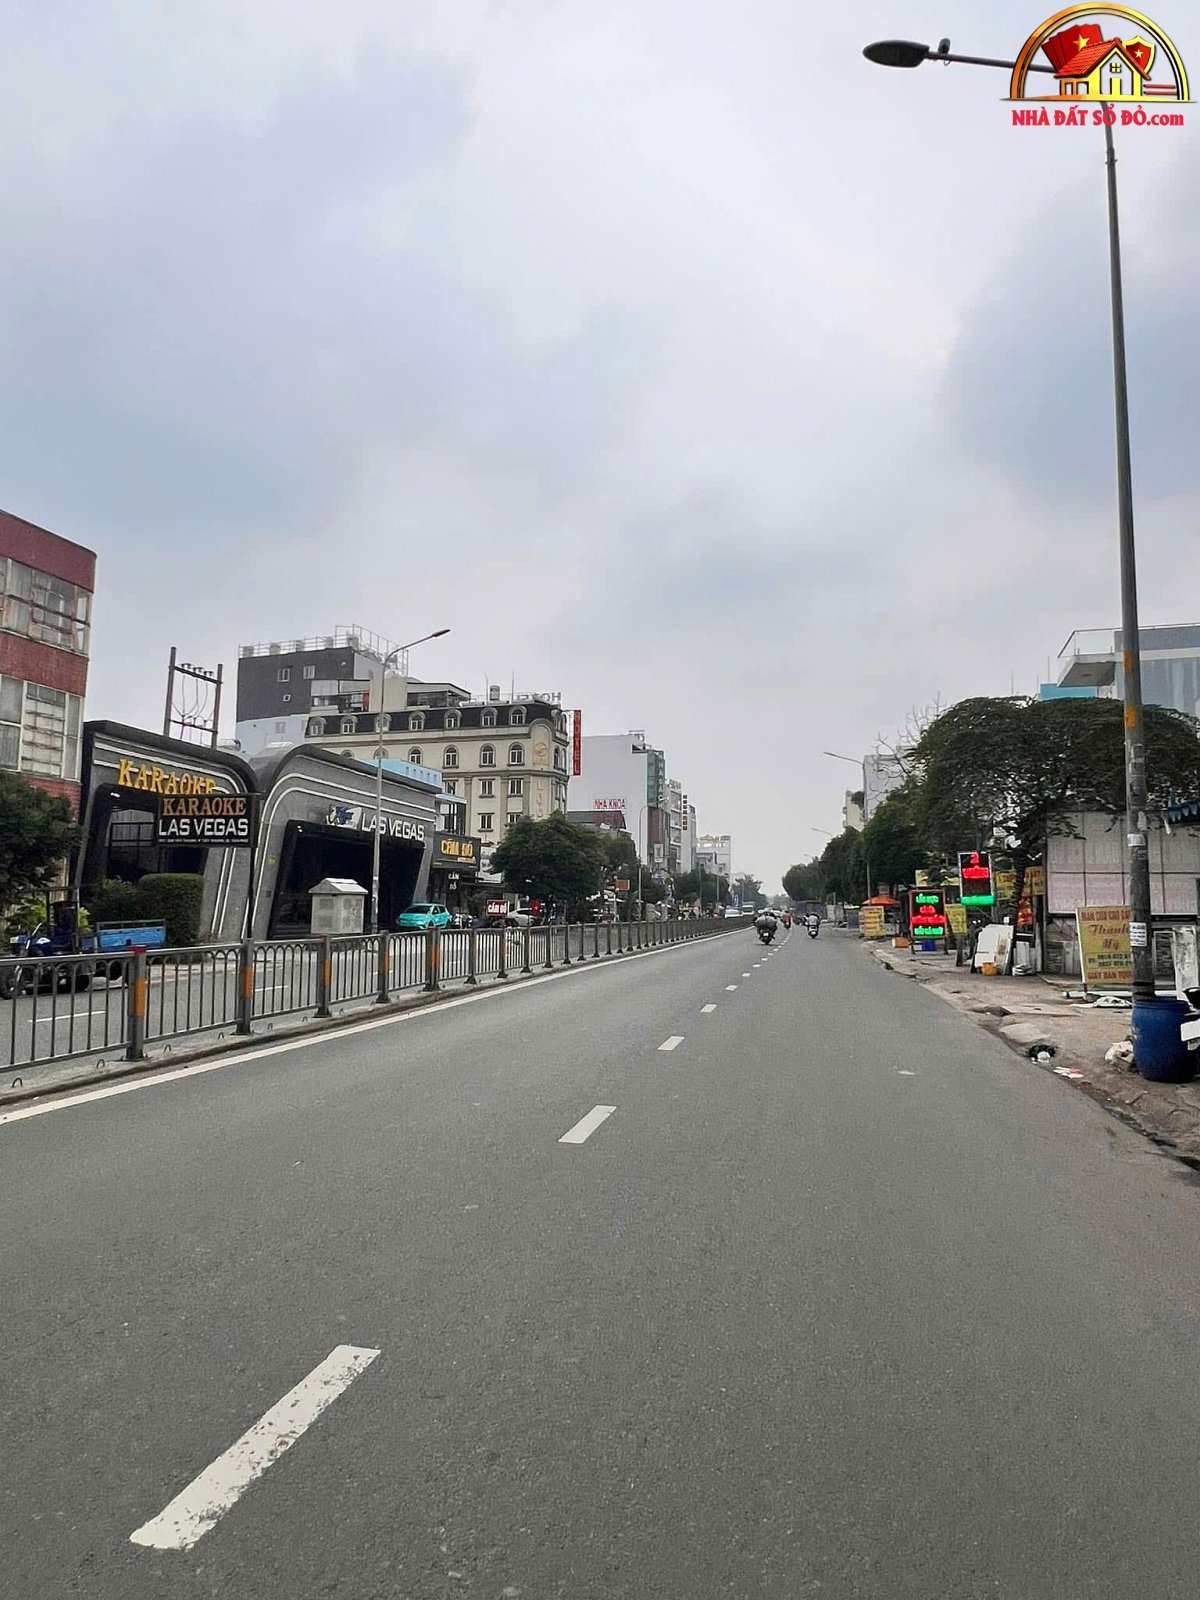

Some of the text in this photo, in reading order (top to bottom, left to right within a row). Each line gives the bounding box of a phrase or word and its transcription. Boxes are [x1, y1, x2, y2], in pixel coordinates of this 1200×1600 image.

[573, 711, 581, 774] HOTEL
[118, 759, 216, 794] KARAOKE
[162, 797, 247, 816] KARAOKE
[158, 818, 249, 836] LAS VEGAS
[362, 812, 425, 841] LAS VEGAS
